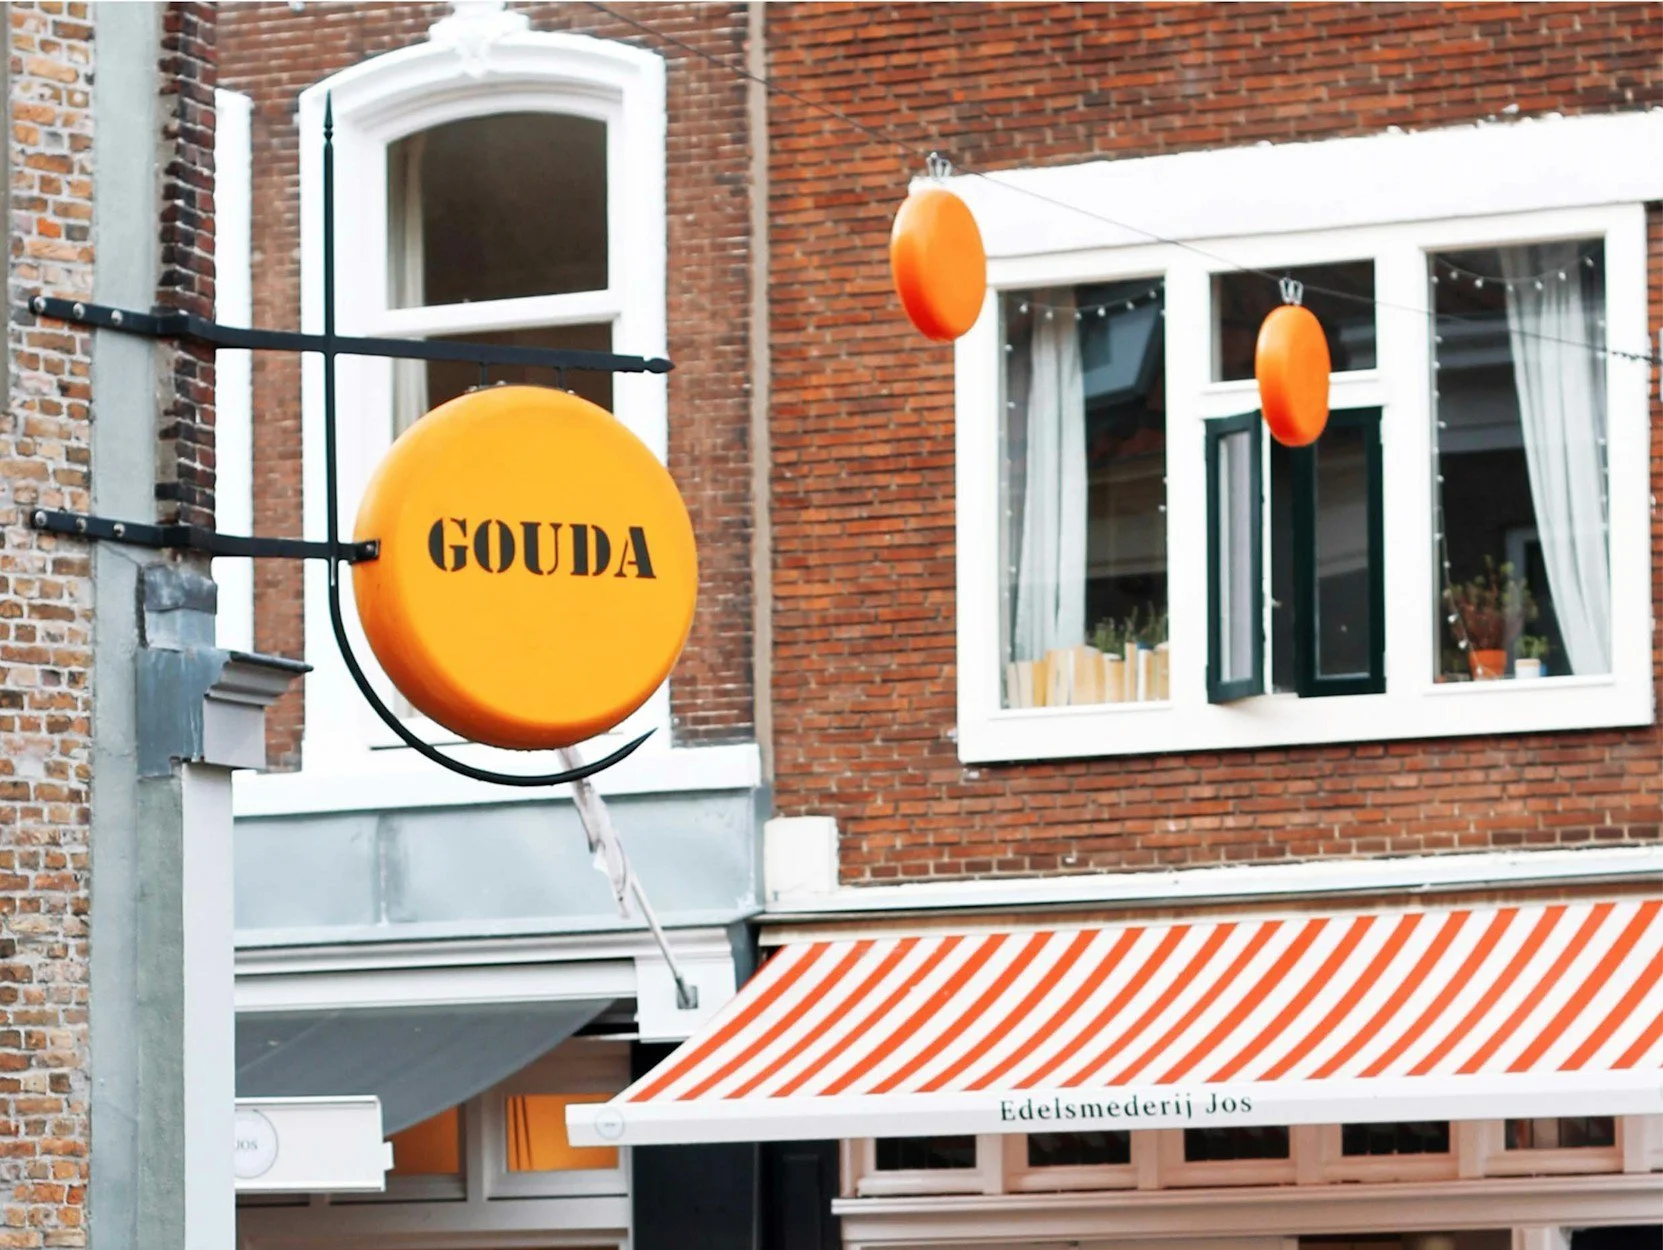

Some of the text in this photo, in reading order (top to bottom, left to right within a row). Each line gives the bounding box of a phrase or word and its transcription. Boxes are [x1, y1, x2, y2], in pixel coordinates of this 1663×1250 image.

[428, 517, 657, 579] GOUDA
[1000, 1092, 1253, 1121] Edelsmederij Jos
